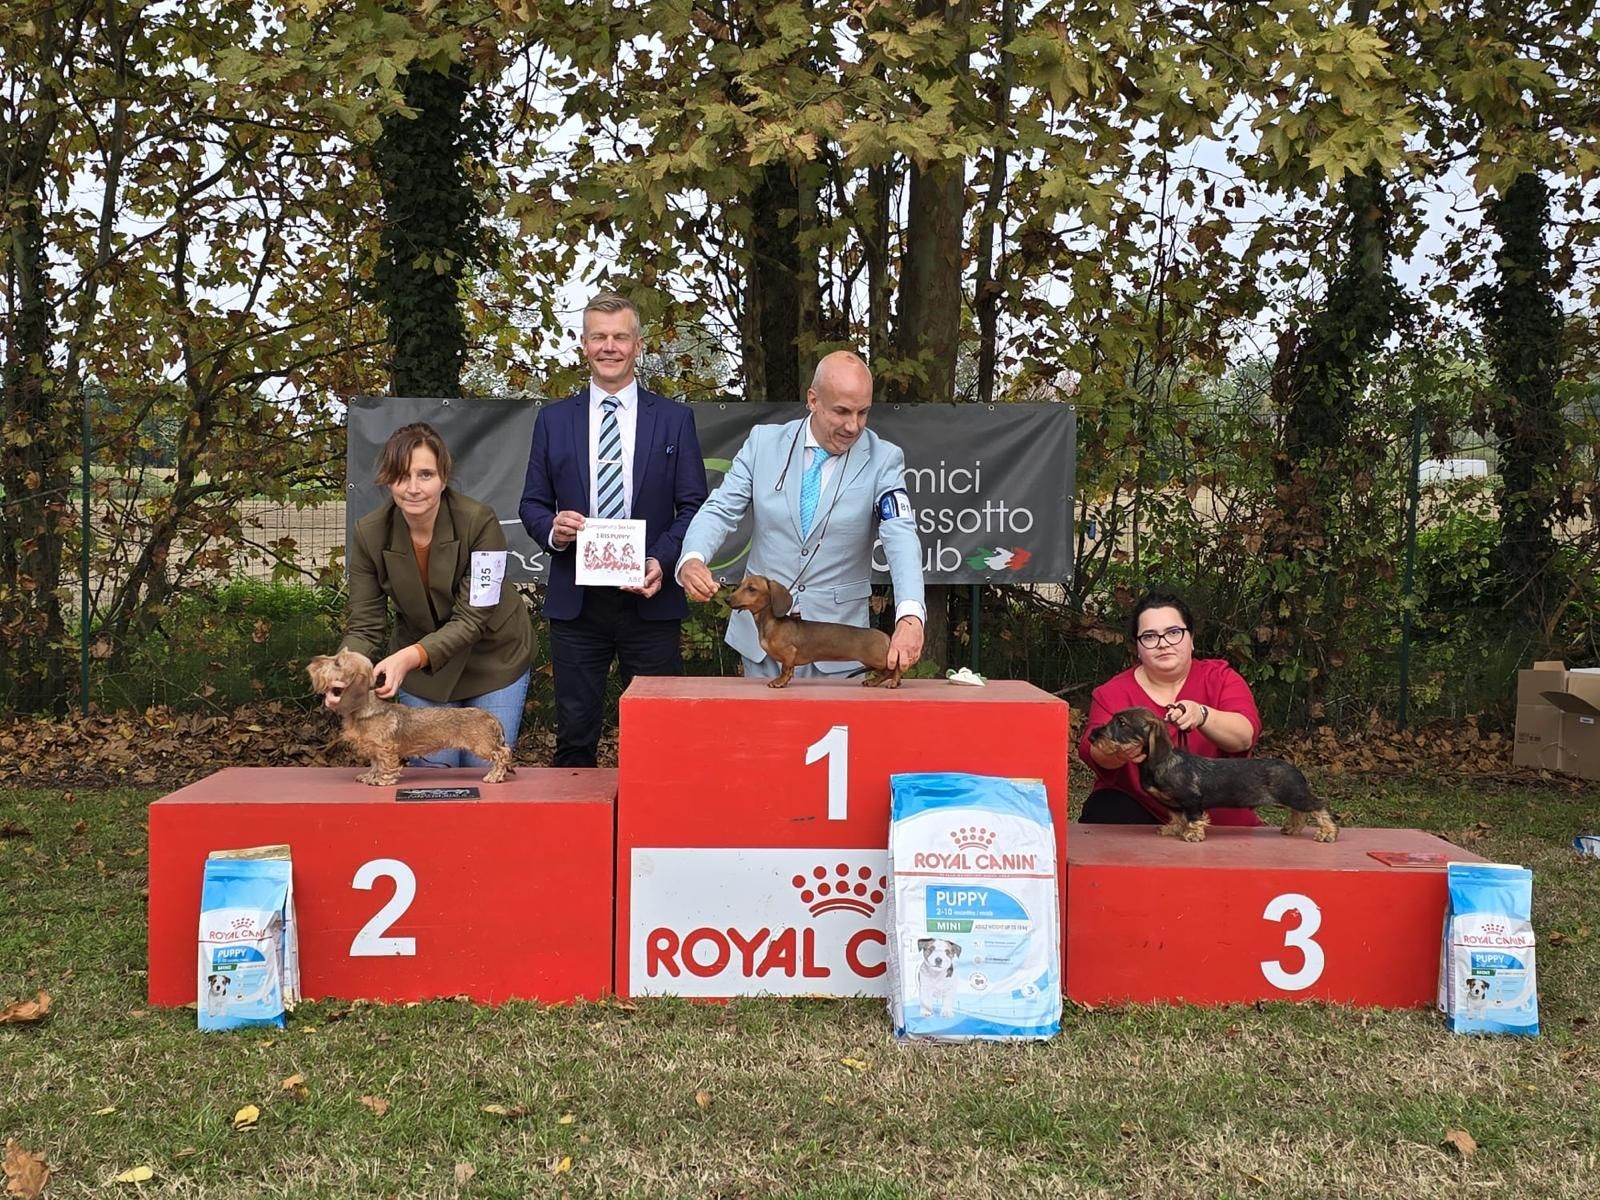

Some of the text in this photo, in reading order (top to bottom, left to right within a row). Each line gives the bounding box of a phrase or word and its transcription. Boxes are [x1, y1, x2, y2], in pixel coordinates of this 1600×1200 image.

[902, 460, 981, 494] mici
[871, 538, 962, 573] Cub
[480, 567, 492, 589] 135
[805, 725, 849, 820] 1
[914, 852, 1035, 871] ROYAL CANIN
[349, 858, 416, 957] 2
[936, 891, 988, 907] PUPPY
[935, 907, 953, 916] 2-10
[209, 930, 239, 940] ROYAL
[936, 922, 961, 932] MINI
[1260, 893, 1325, 991] 3
[1464, 935, 1526, 945] ROYAL CANIN
[217, 948, 247, 958] PUPPY
[646, 927, 831, 978] ROYAL
[1476, 954, 1505, 964] PUPPY
